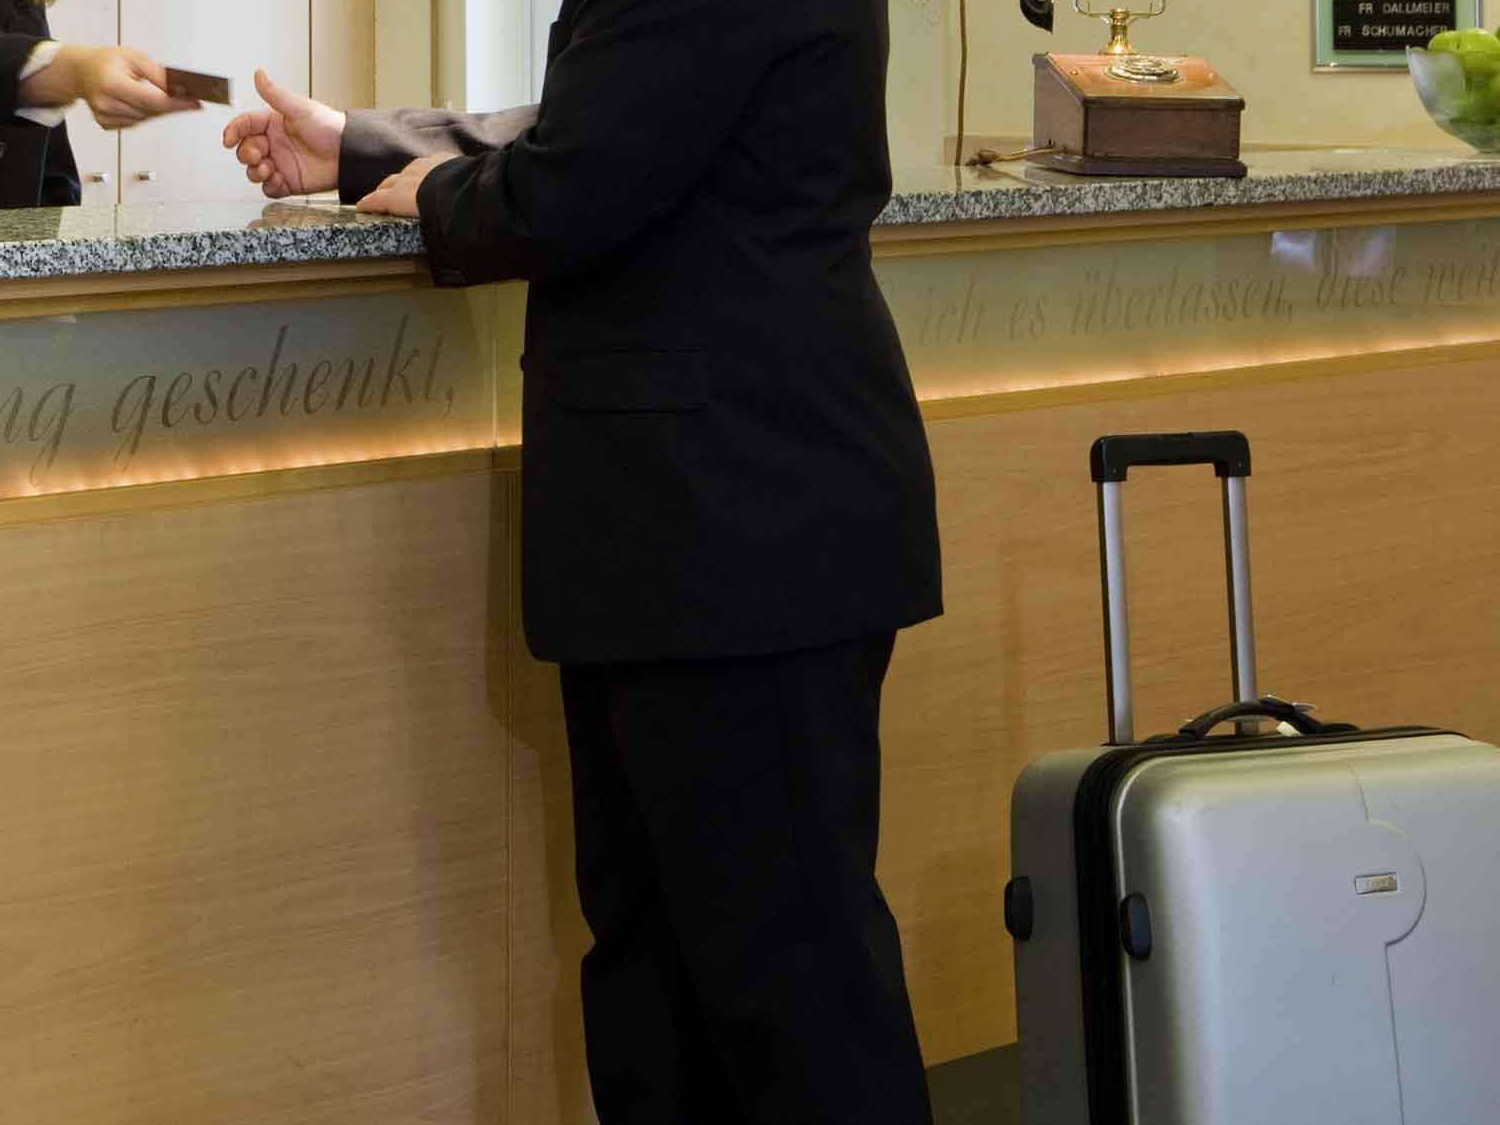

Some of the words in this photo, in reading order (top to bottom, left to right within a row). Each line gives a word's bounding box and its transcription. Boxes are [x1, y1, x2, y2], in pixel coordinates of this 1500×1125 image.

[1358, 2, 1373, 14] FR
[1007, 295, 1050, 341] es
[111, 313, 456, 473] geschenkt,
